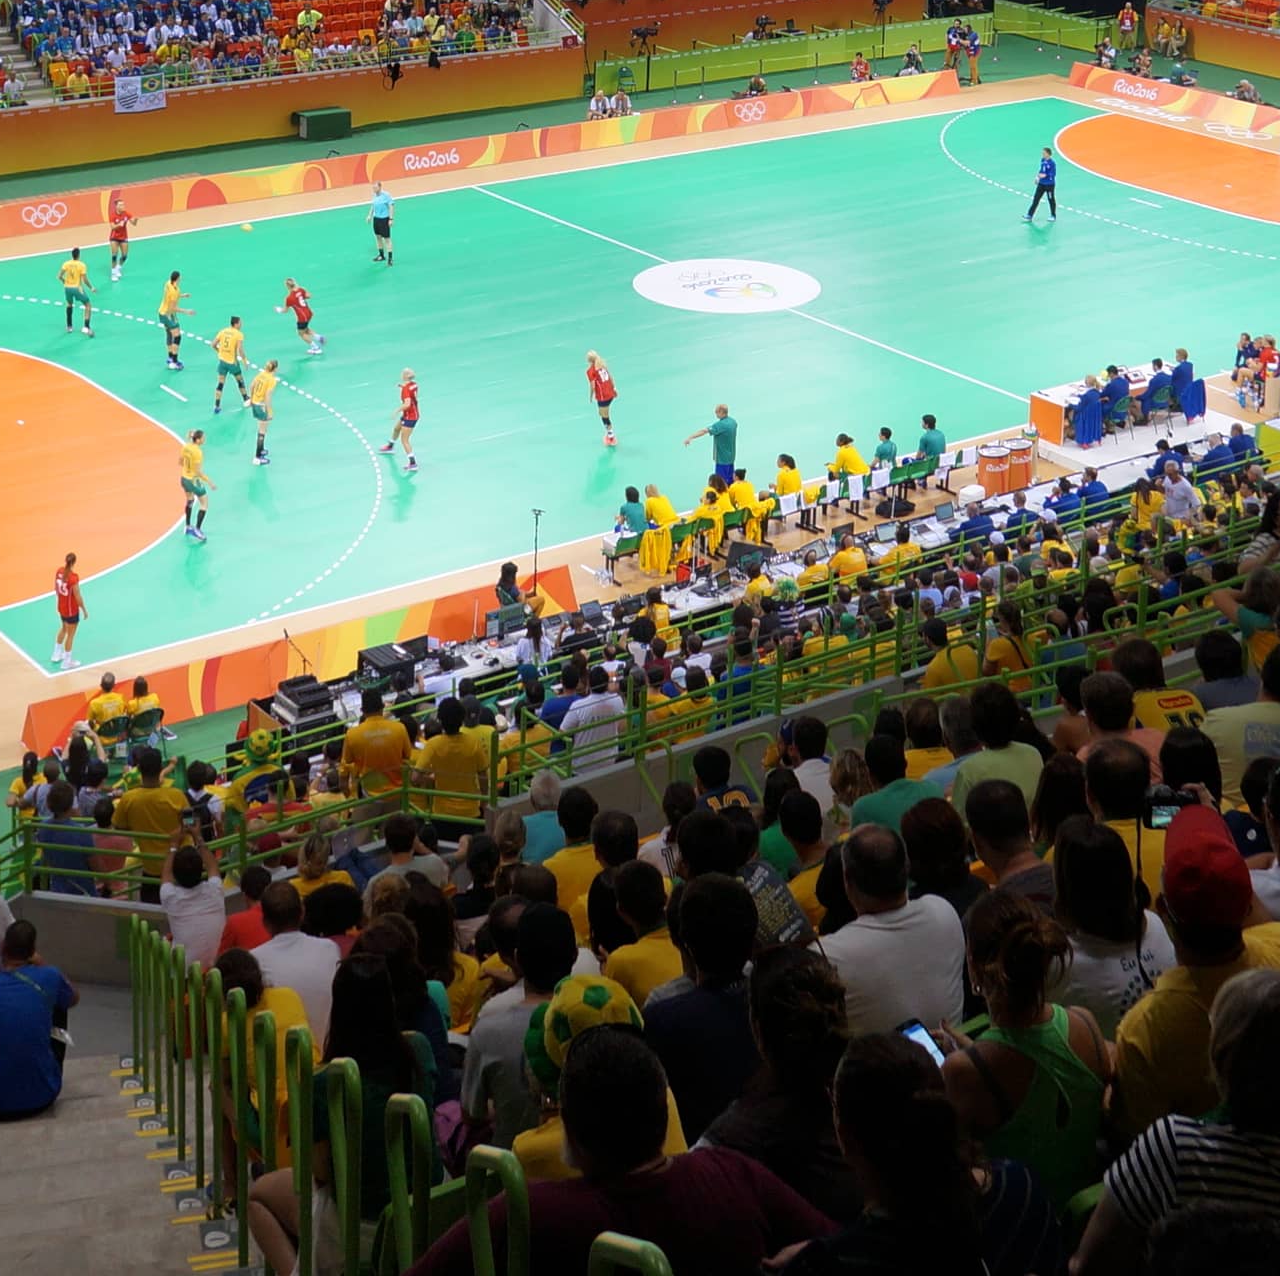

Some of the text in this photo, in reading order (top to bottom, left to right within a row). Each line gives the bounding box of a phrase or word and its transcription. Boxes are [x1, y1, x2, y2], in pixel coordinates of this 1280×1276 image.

[1113, 78, 1159, 101] Rio2016
[404, 147, 460, 171] Rio2016
[223, 336, 230, 348] 5
